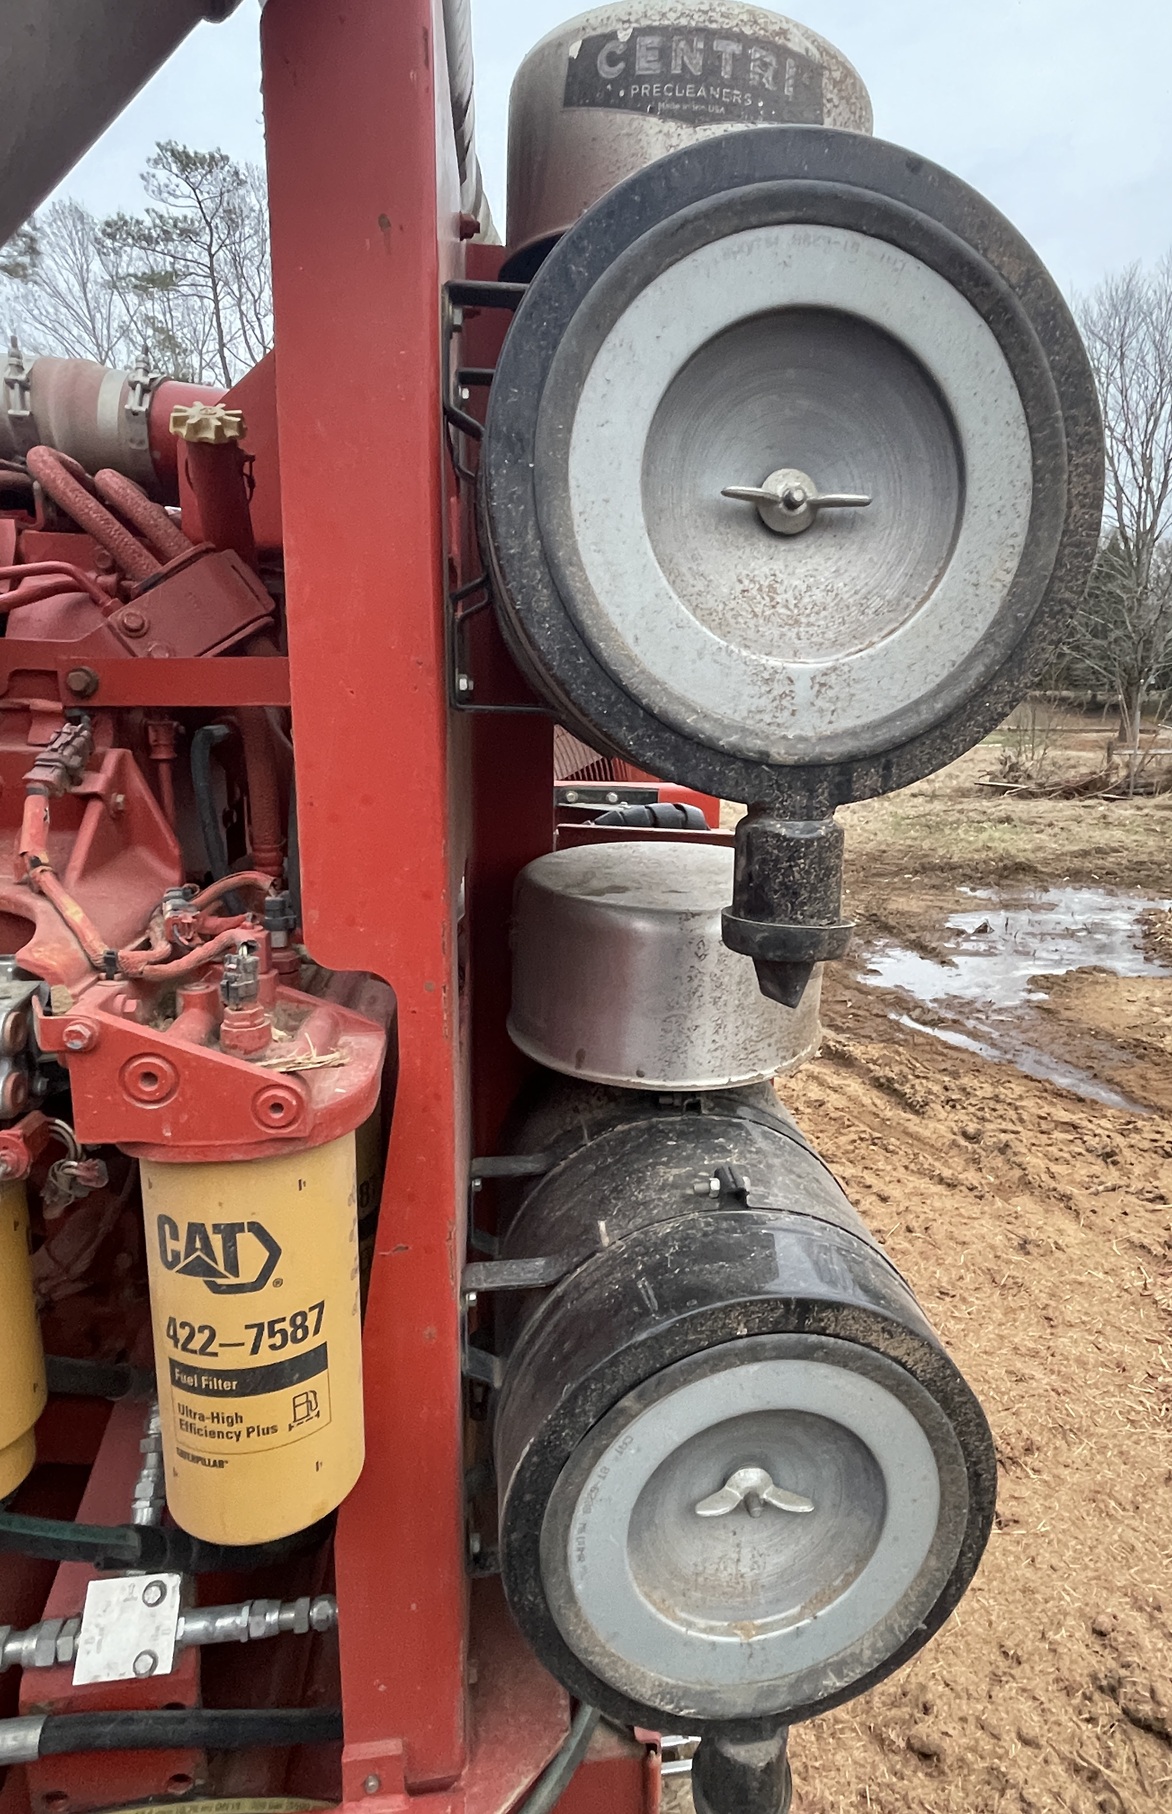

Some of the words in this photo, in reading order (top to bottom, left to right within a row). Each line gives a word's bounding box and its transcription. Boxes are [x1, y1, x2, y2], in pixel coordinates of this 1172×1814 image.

[597, 35, 795, 96] CENTRI
[630, 83, 752, 106] PRECLEANERS
[157, 1213, 245, 1279] CAT
[166, 1300, 325, 1357] 422-7587
[174, 1368, 198, 1388] Fuel
[201, 1375, 238, 1391] Filter
[177, 1402, 243, 1427] Ultra-High
[179, 1418, 242, 1442] Efficiency
[246, 1424, 278, 1438] Plus
